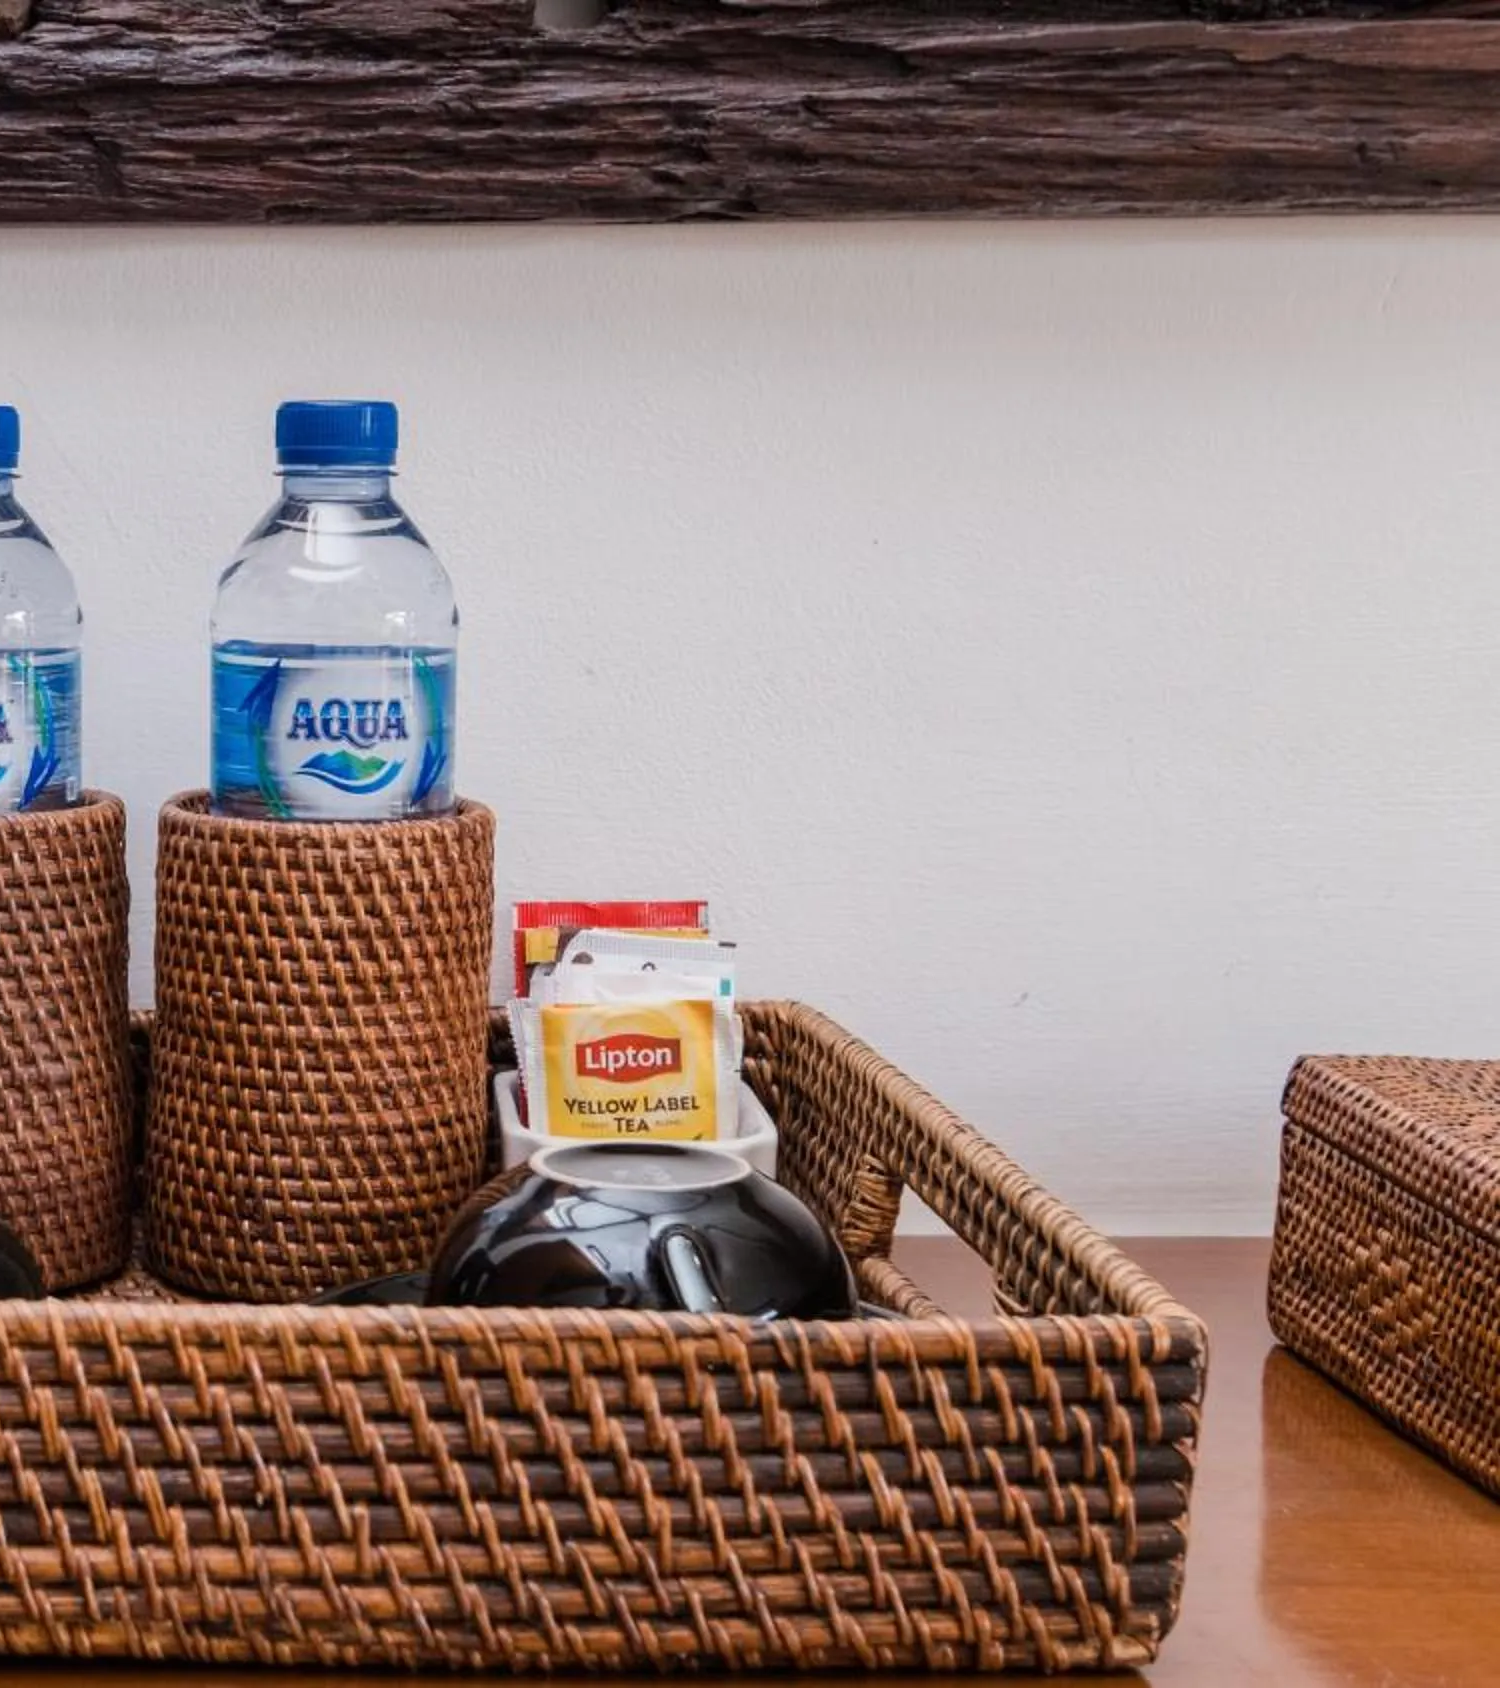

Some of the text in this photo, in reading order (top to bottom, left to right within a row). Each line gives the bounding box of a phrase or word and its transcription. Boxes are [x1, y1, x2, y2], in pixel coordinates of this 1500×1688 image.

[285, 698, 408, 749] AQUA
[584, 1046, 673, 1075] Lipton
[563, 1095, 700, 1115] YELLOW LABEL
[613, 1116, 650, 1133] TEA
